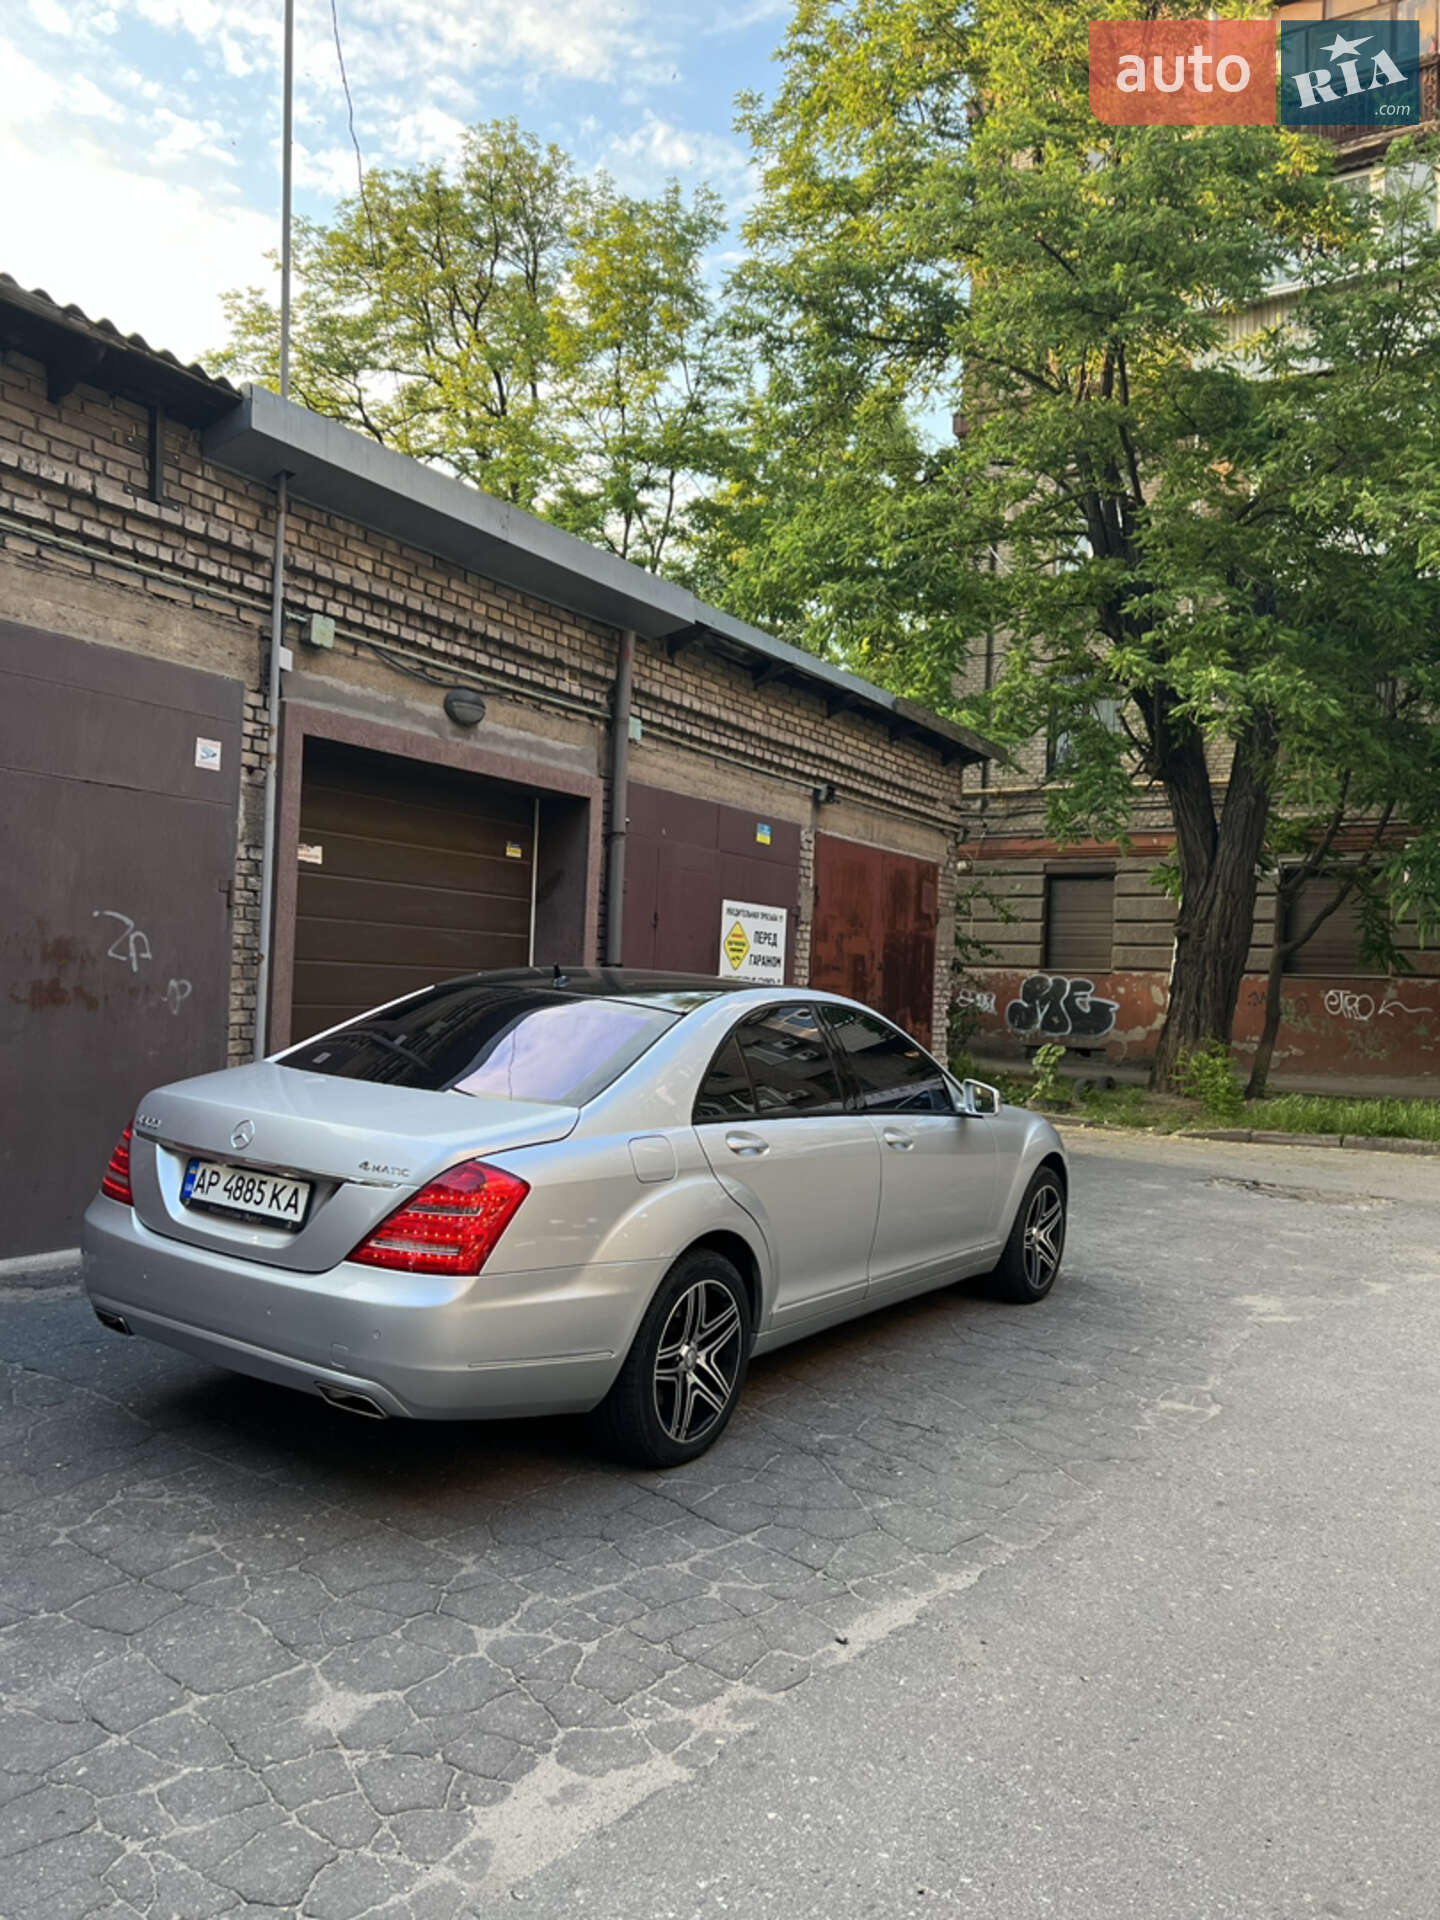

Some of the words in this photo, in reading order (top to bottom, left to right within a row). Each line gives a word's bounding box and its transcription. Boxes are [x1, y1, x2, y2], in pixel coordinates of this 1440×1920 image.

[753, 930, 778, 948] ПЕРЕД
[748, 953, 782, 968] ГАРАЖОМ
[194, 1168, 220, 1195] AP
[223, 1174, 267, 1206] 4885
[268, 1183, 299, 1214] KA
